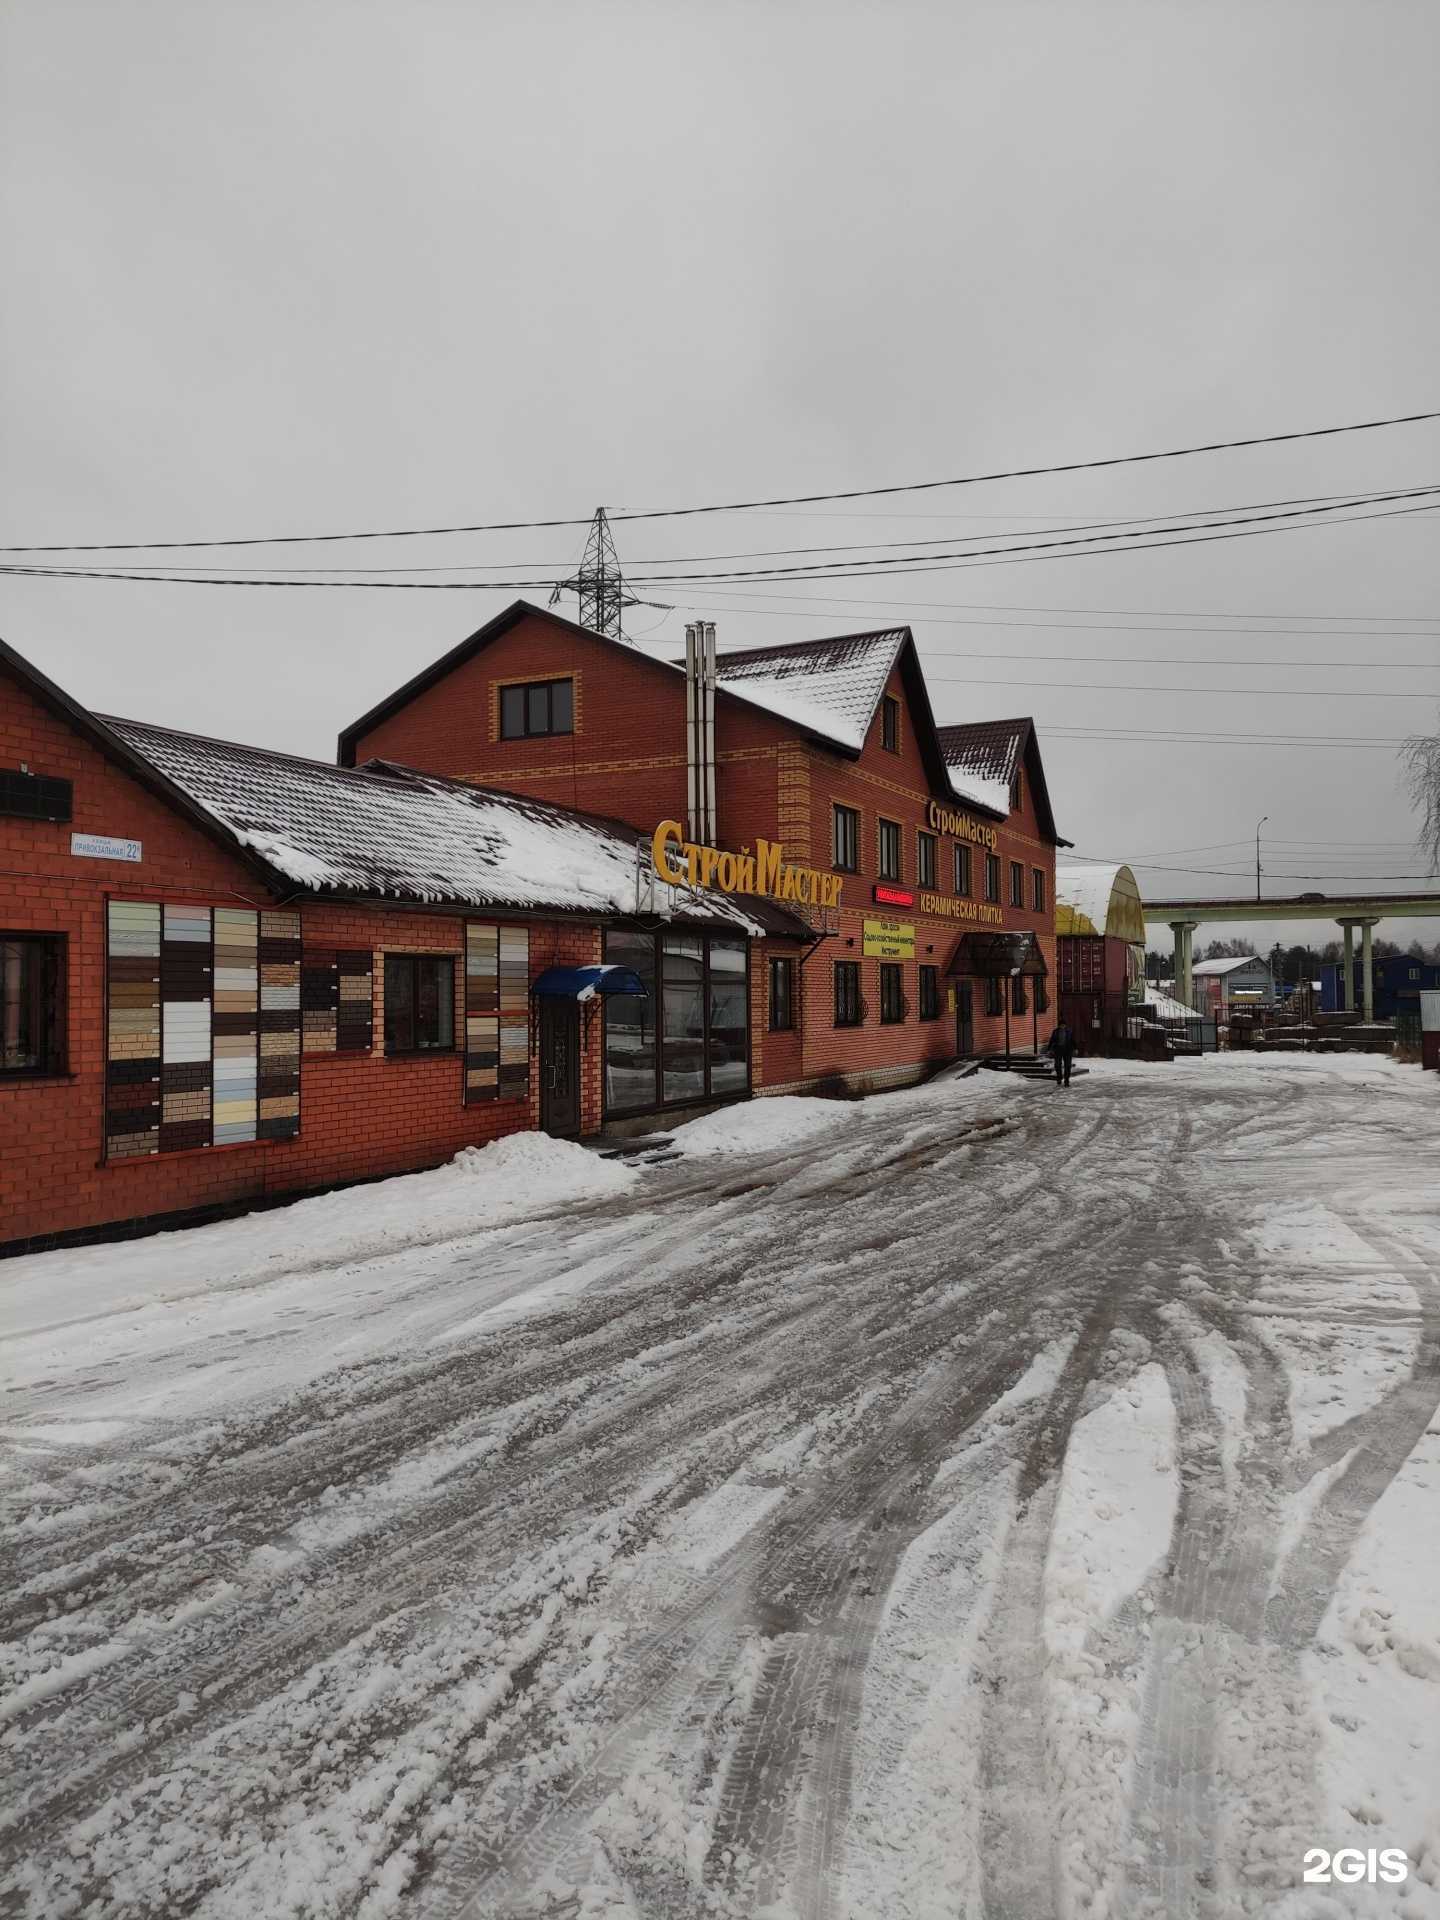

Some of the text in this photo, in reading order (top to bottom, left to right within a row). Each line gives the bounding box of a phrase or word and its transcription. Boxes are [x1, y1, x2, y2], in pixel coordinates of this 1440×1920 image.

[929, 800, 998, 850] СтройМастер
[74, 843, 124, 856] ПРИВОКЗАЛЬНАЯ
[920, 893, 977, 920] КЕРАМИЧЕСКАЯ
[978, 904, 1003, 925] ПЛИТКА
